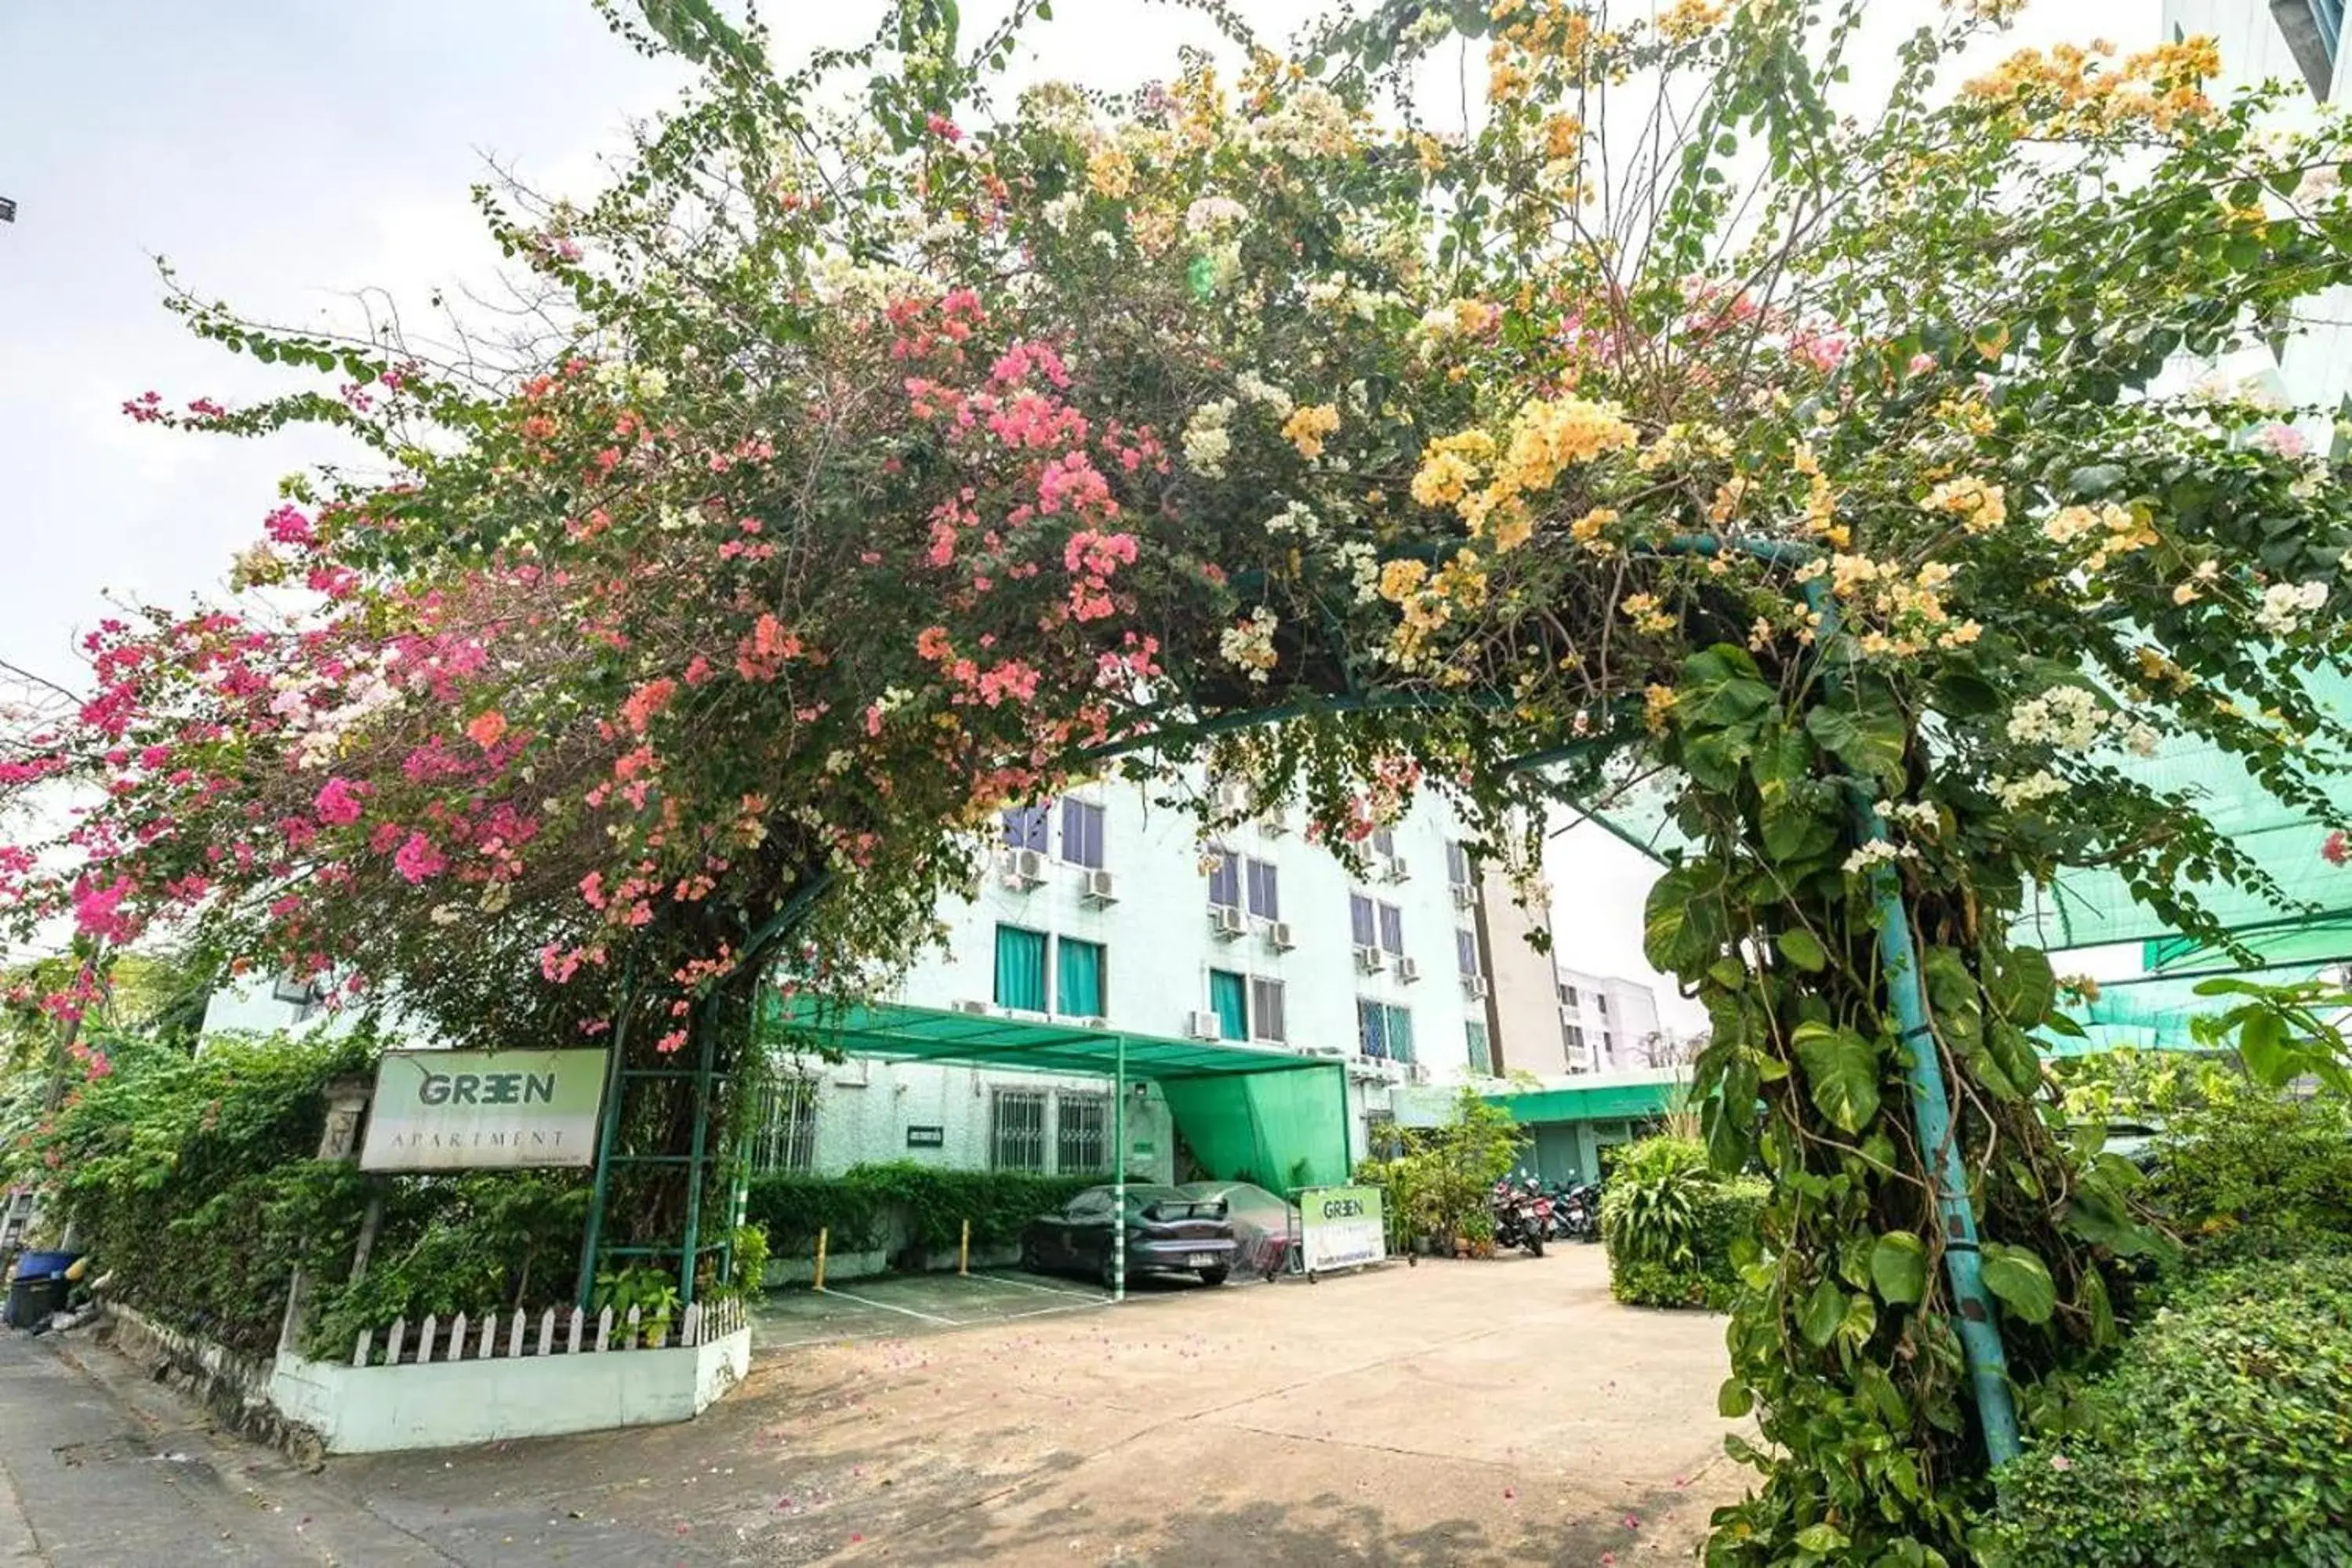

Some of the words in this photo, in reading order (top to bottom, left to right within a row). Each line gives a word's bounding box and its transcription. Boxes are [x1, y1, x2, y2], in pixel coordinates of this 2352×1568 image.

[419, 1073, 555, 1105] GREEN
[392, 1130, 564, 1148] APARTMENT
[1323, 1199, 1364, 1219] GREEN
